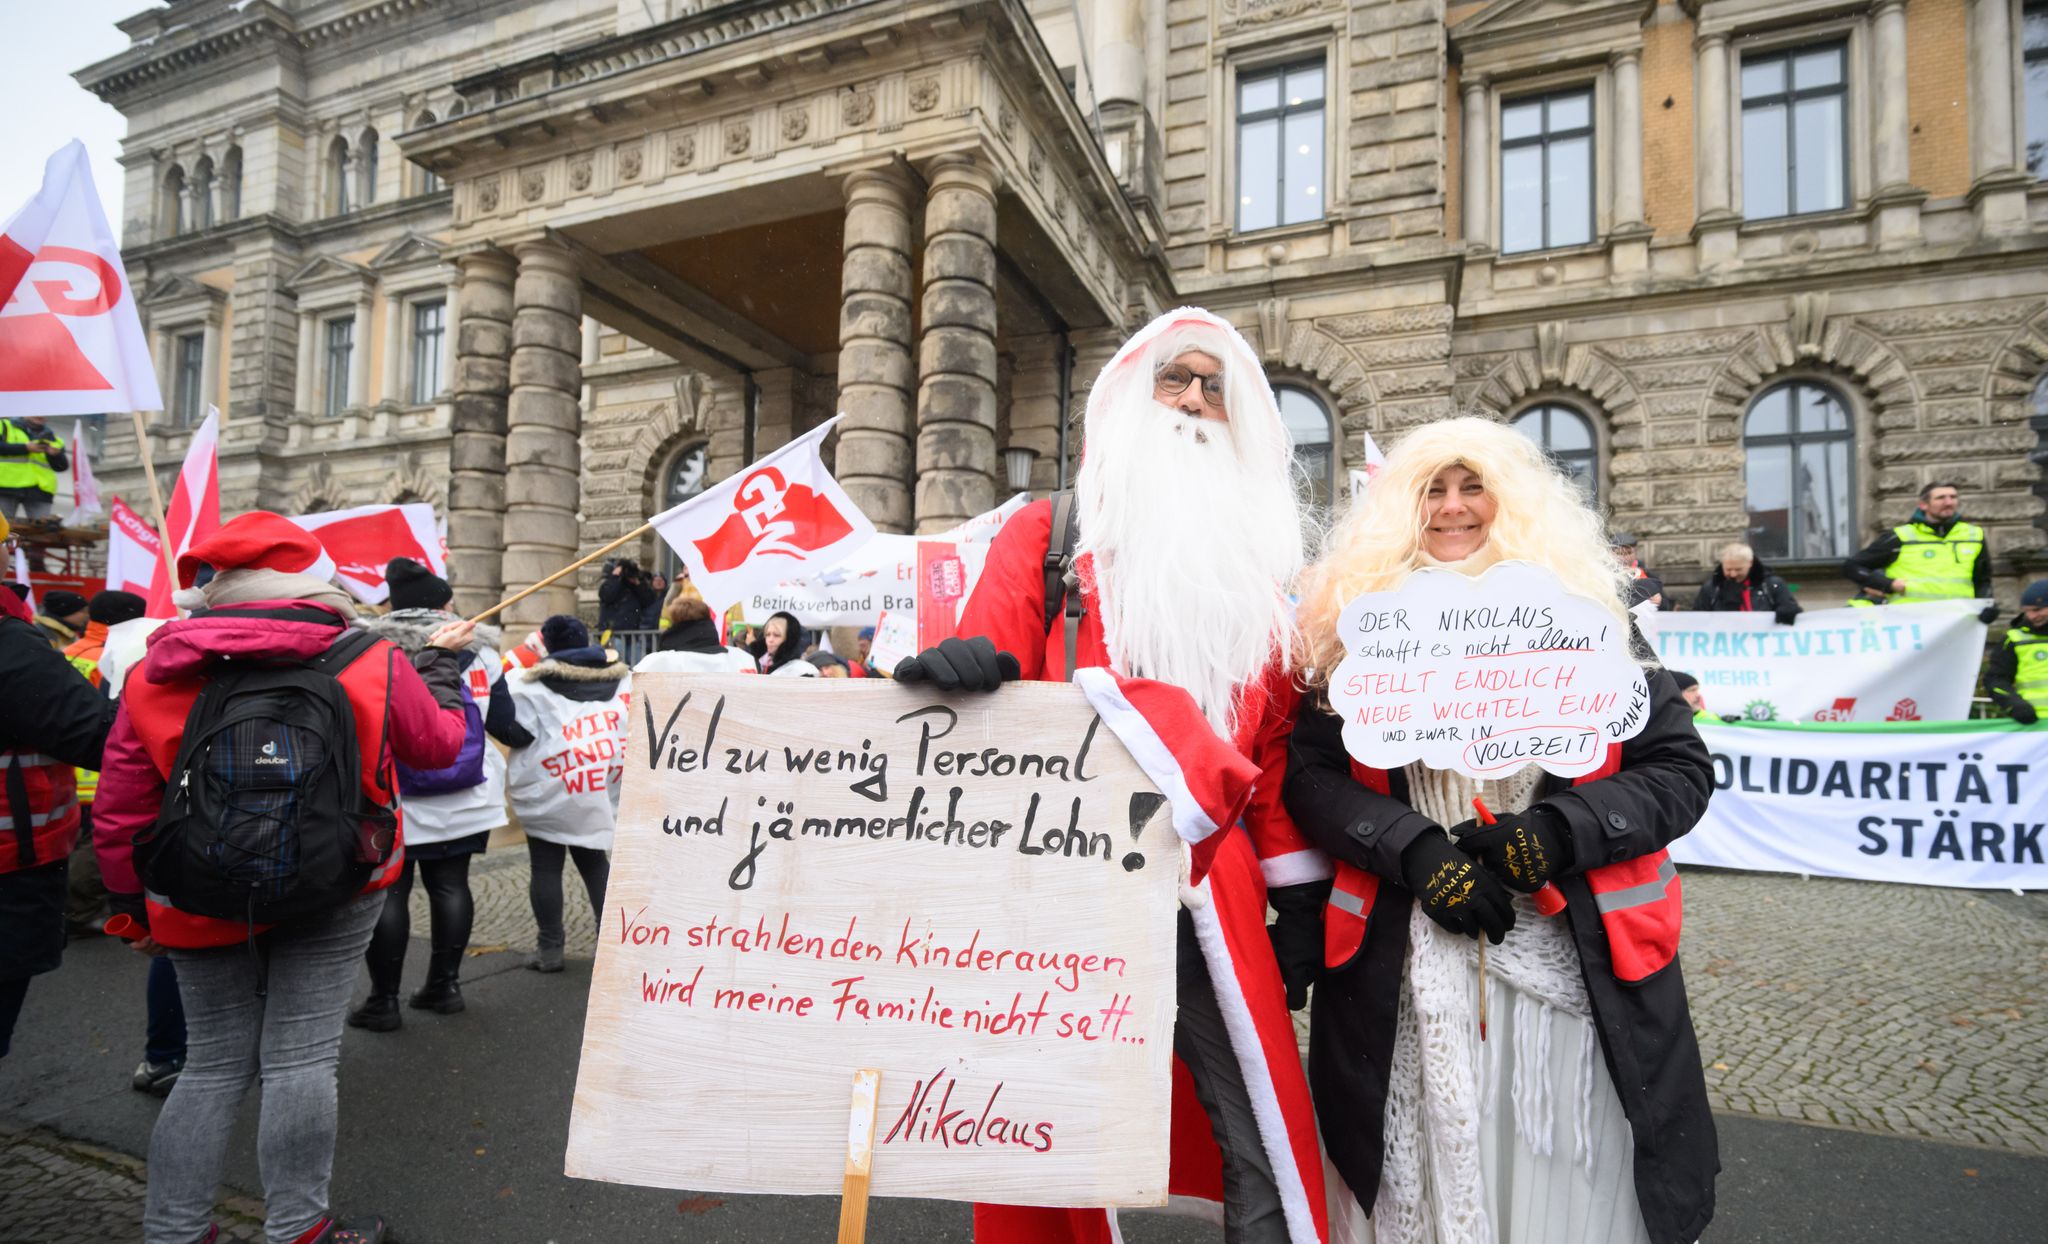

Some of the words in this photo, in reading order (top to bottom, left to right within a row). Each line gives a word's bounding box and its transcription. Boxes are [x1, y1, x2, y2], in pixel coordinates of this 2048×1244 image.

[752, 595, 872, 613] Bezirksverband
[883, 594, 914, 610] Bra
[1358, 608, 1410, 632] DER
[1439, 606, 1553, 632] NIKOLAUS
[1358, 638, 1421, 664] schafft
[1431, 642, 1451, 659] es
[1465, 635, 1511, 657] nicht
[1654, 621, 1923, 657] TTRAKTIVITÄT!
[1344, 670, 1436, 696] STELLT
[1454, 665, 1577, 691] ENDLICH
[1357, 703, 1412, 725] NEUE
[1433, 697, 1540, 721] WICHTEL
[1558, 692, 1617, 716] EIN!
[1606, 680, 1648, 737] DANKE
[562, 710, 620, 741] WIR
[1382, 729, 1406, 743] UND
[1415, 726, 1463, 742] ZWAR
[1472, 725, 1493, 741] IN
[255, 756, 289, 765] deuter
[541, 738, 614, 777] SIND
[643, 691, 726, 772] Viel
[725, 748, 768, 774] zu
[784, 739, 888, 802] wenig
[896, 705, 1099, 781] Personal
[1473, 732, 1596, 765] VOLLZEIT
[1709, 752, 2029, 804] OLIDARITÄT
[662, 796, 728, 837] und
[728, 786, 1013, 891] jämmerlicher
[621, 906, 670, 946] Von
[687, 912, 883, 961] strahlenden
[713, 983, 814, 1017] meine
[831, 975, 954, 1029] Familie
[963, 990, 1050, 1035] nicht
[882, 1067, 1054, 1152] Nikolaus
